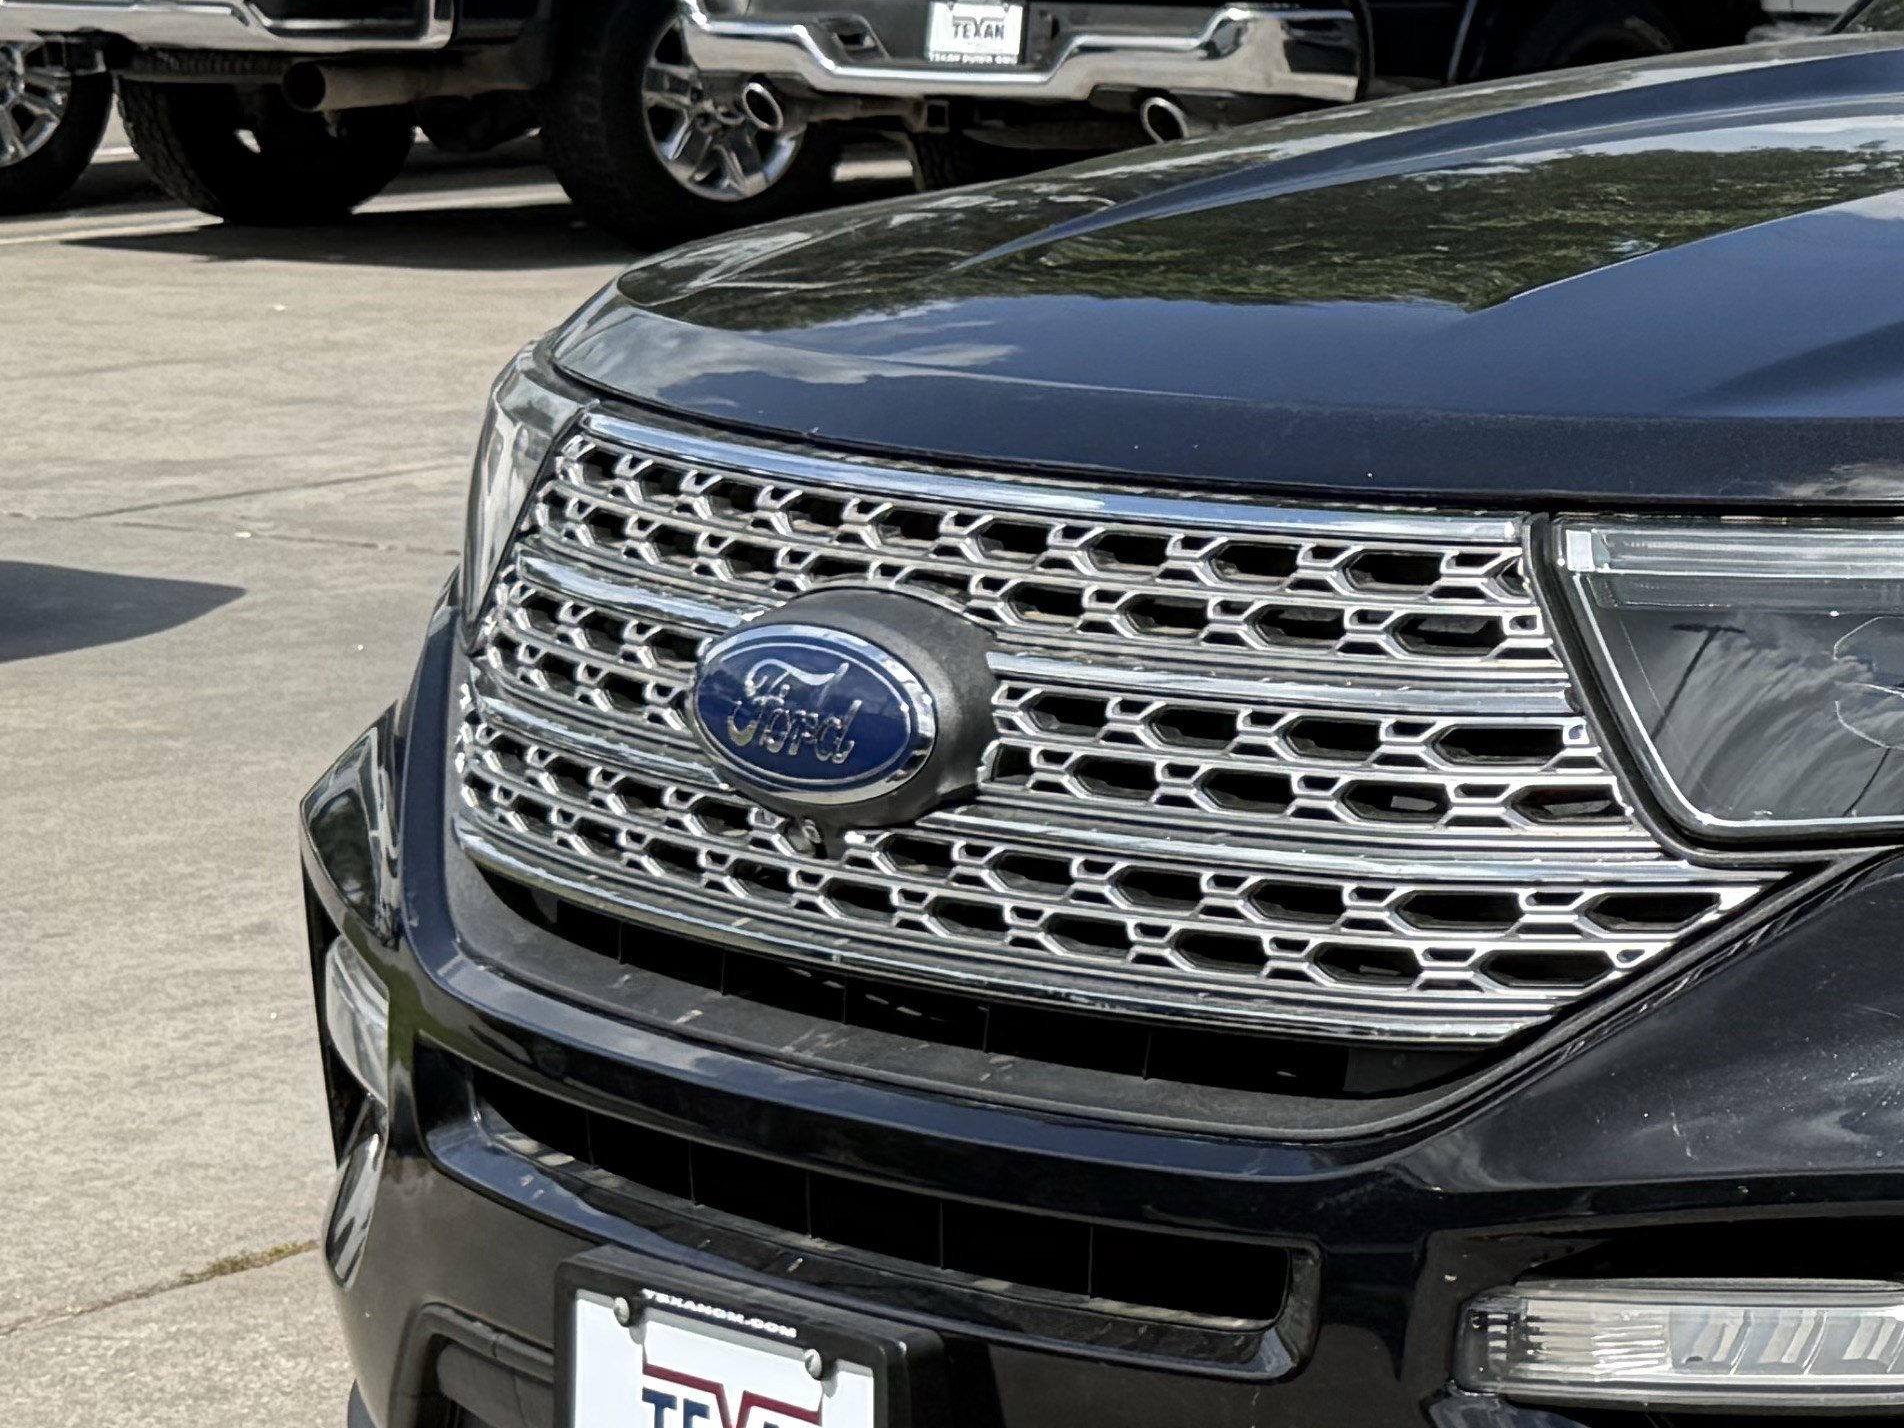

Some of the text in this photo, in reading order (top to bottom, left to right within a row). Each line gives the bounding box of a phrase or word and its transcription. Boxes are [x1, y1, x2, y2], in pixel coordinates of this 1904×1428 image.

[952, 16, 1005, 41] TEXAN
[727, 657, 863, 765] Ford
[641, 1288, 798, 1339] TEXANGM.COM
